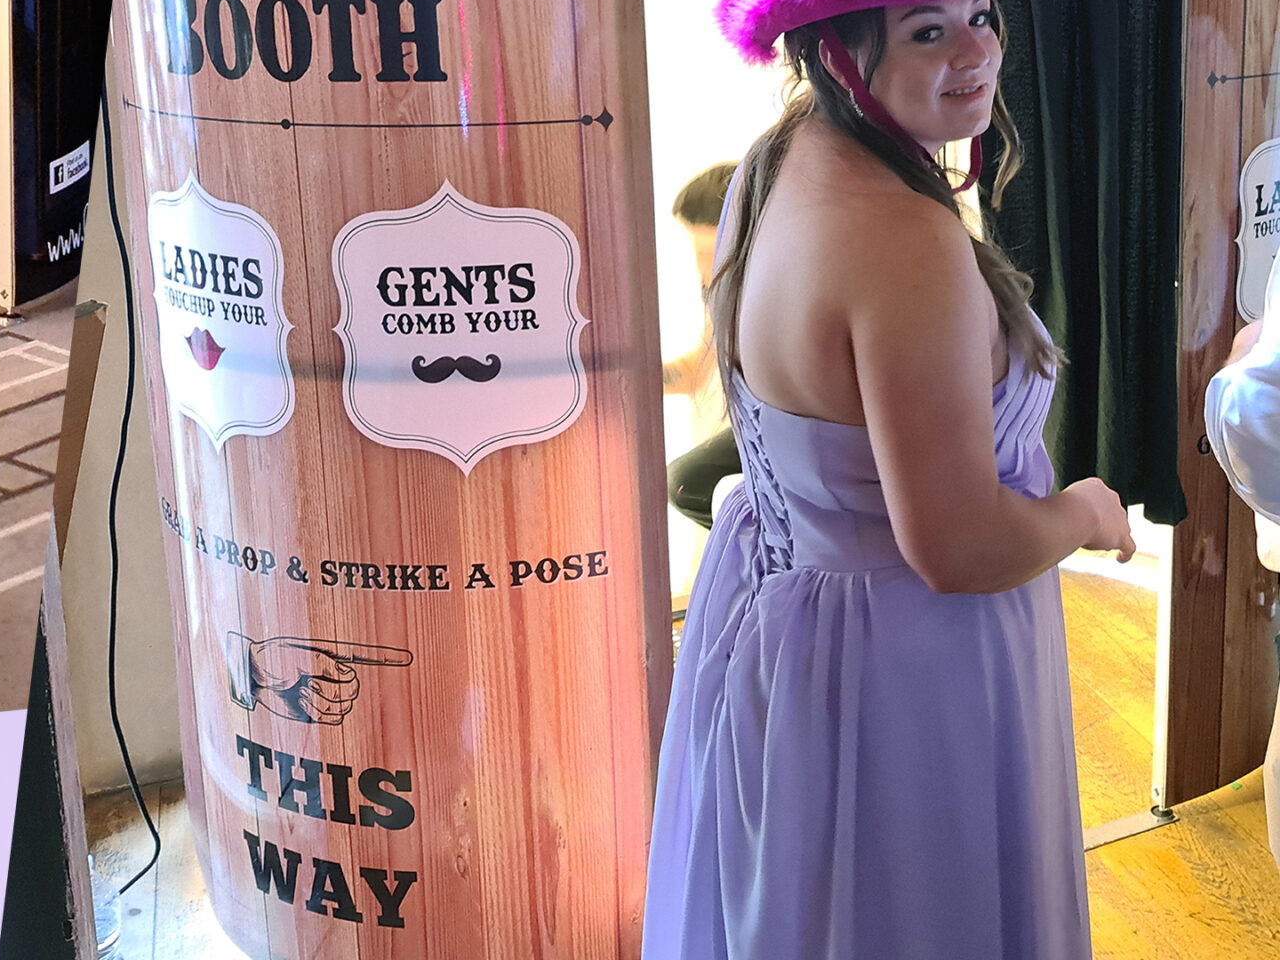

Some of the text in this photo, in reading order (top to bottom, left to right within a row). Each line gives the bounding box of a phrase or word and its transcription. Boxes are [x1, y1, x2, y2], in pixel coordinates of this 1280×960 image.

[160, 241, 264, 299] LADIES
[376, 262, 537, 309] GENTS
[164, 285, 268, 326] TOUCHUP YOUR
[381, 309, 540, 335] COMB YOUR
[196, 526, 209, 554] A
[214, 535, 277, 576] PROP
[286, 556, 309, 583] &
[320, 560, 450, 591] STRIKE
[465, 563, 496, 590] A
[509, 550, 610, 587] POSE
[236, 734, 416, 831] THIS
[243, 830, 418, 929] WAY
